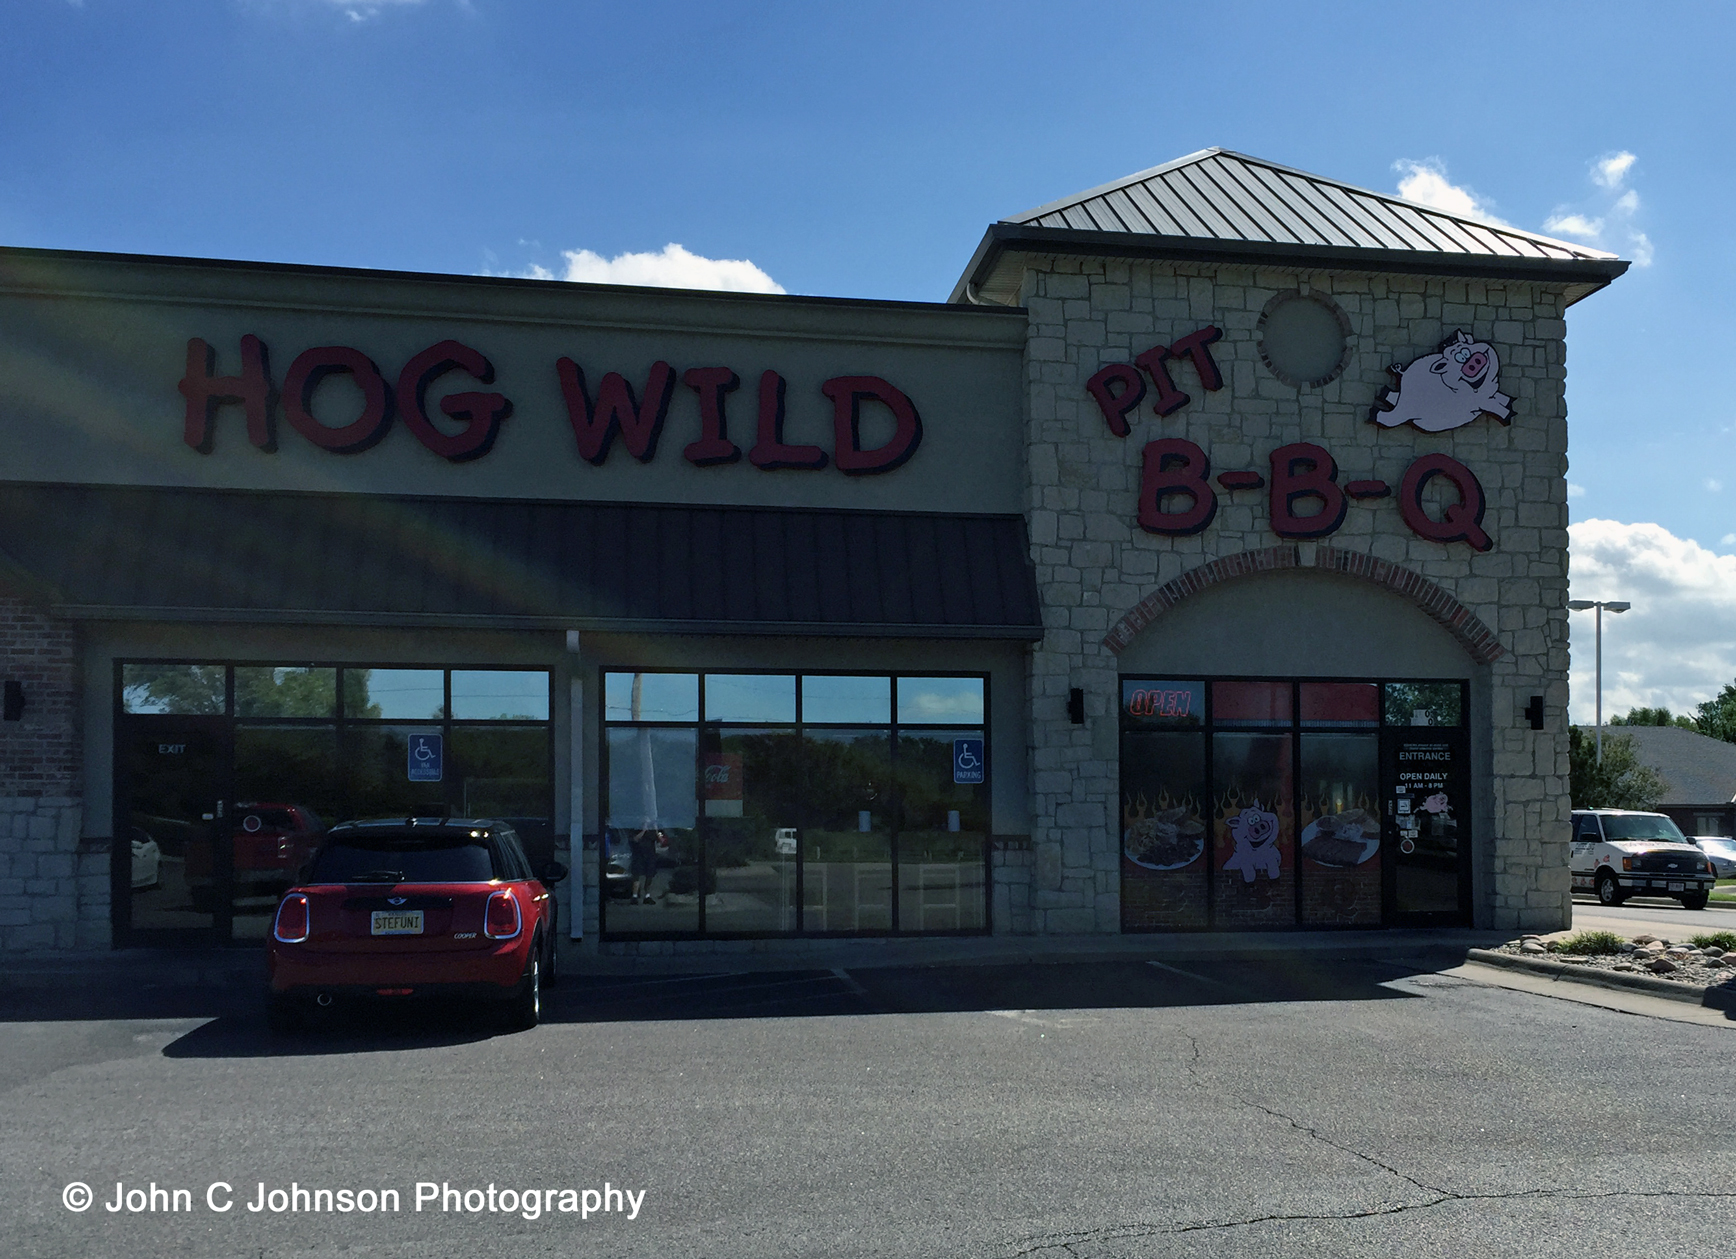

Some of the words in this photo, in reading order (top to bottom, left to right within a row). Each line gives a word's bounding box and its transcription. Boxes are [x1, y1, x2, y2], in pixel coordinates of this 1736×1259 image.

[1087, 325, 1223, 437] PIT
[178, 334, 513, 464] HOG
[556, 356, 924, 476] WILD
[1137, 437, 1494, 552] B-B-Q
[1129, 689, 1191, 717] OPEN
[158, 744, 186, 754] EXIT
[1399, 751, 1451, 761] ENTRANCE
[956, 770, 982, 779] PARKING
[1399, 772, 1422, 781] OPEN
[1424, 772, 1448, 780] DAILY
[375, 916, 420, 929] STEFUNI
[454, 932, 477, 940] COOPER
